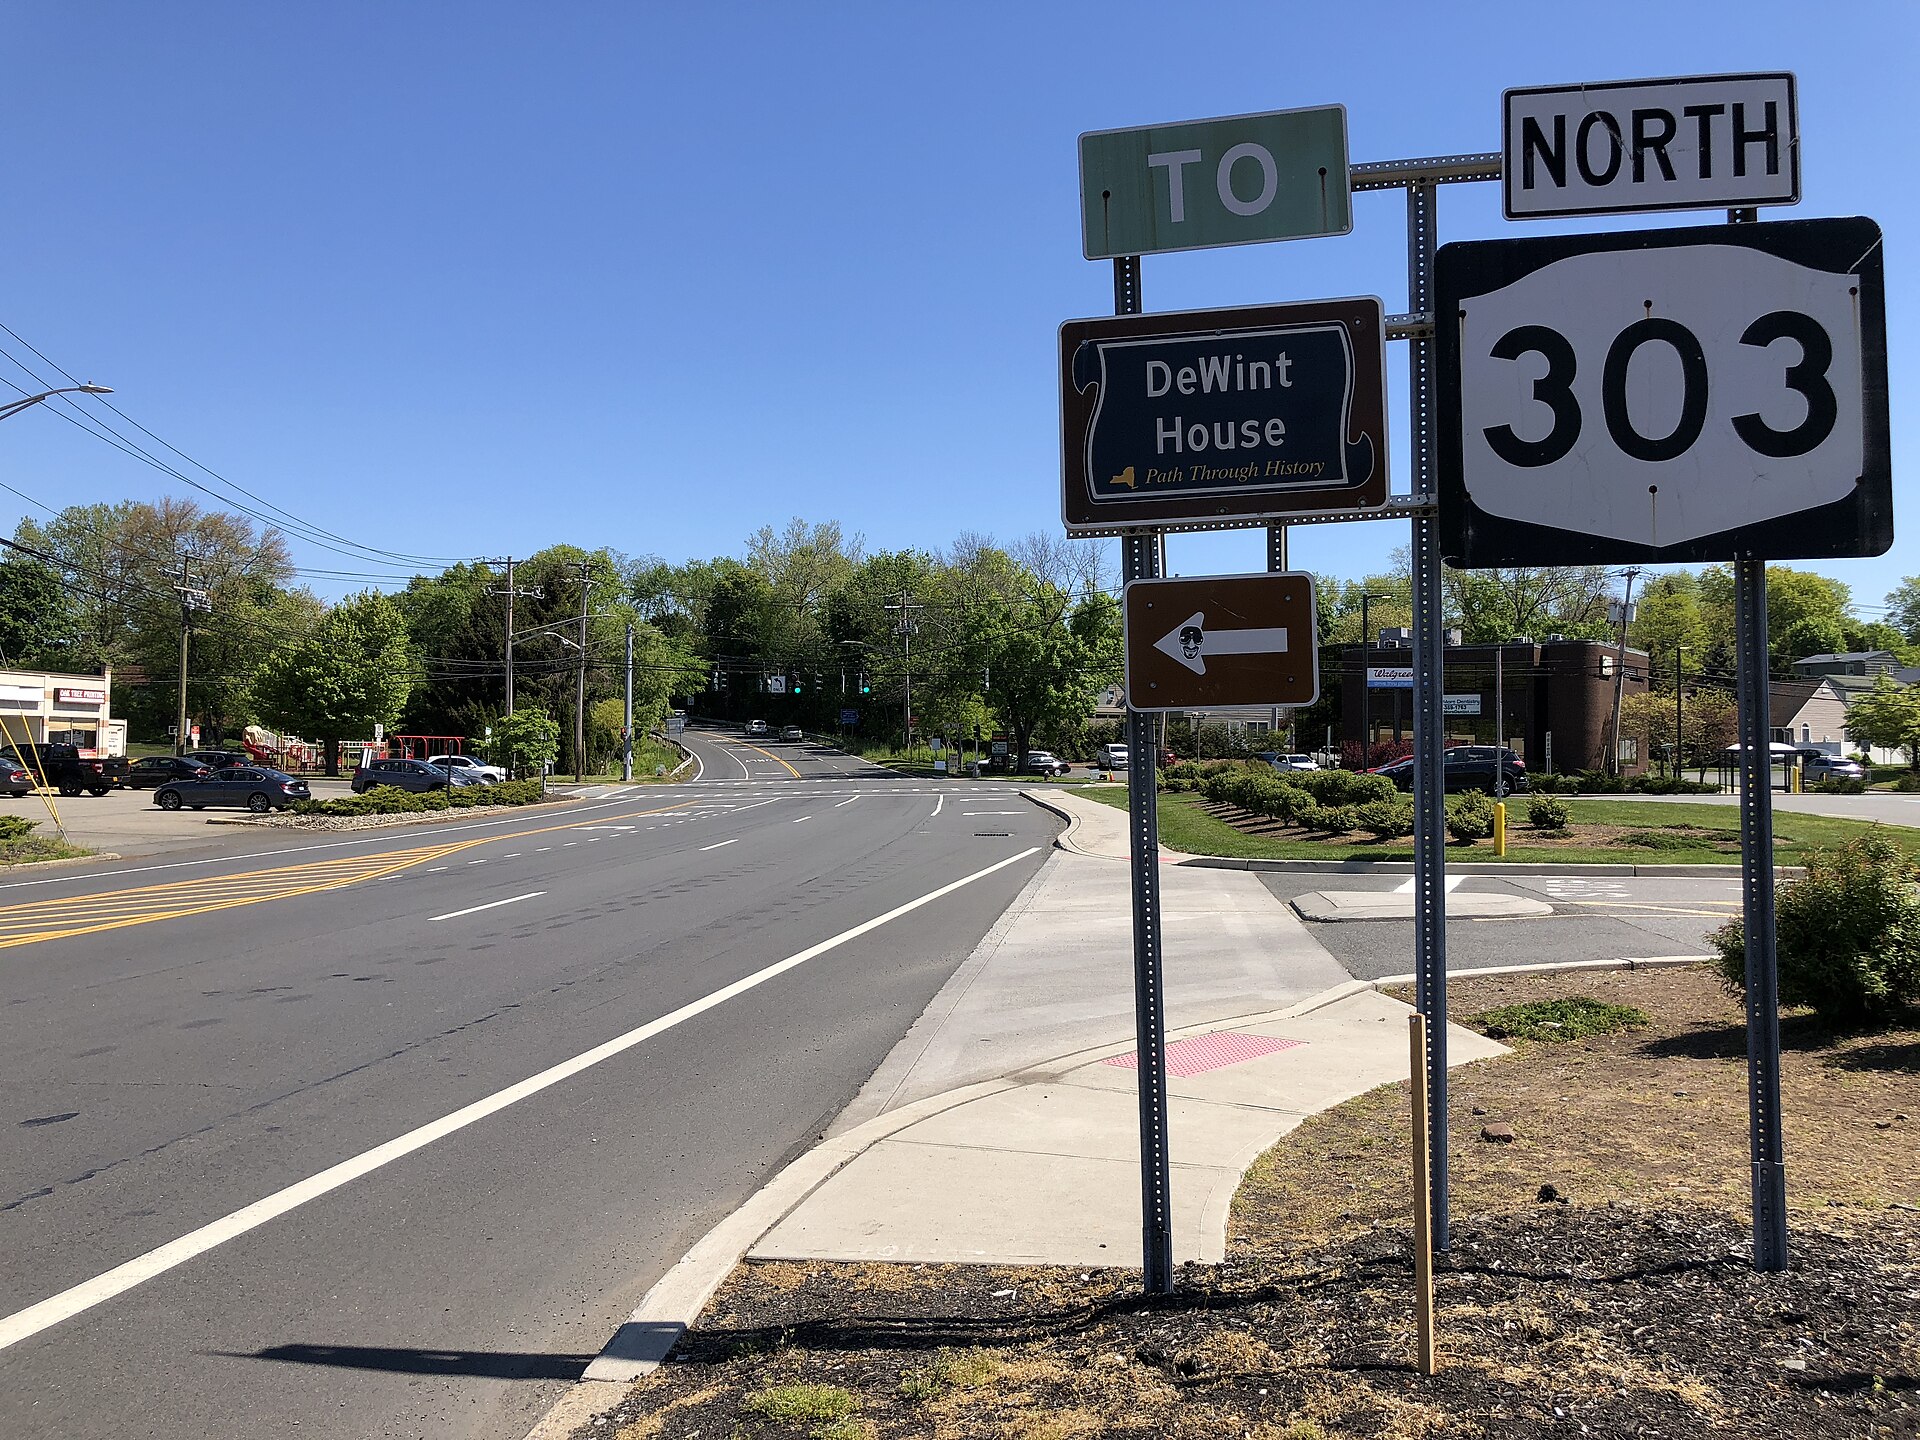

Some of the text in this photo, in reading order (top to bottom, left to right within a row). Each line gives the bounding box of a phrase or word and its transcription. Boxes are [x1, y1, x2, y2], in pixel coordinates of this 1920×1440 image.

[1522, 101, 1779, 190] NORTH
[1147, 142, 1278, 223] TO
[1146, 351, 1293, 397] DeWint
[1482, 310, 1838, 468] 303
[1156, 417, 1286, 454] House
[1145, 459, 1325, 488] Path Through History
[60, 689, 105, 699] OAK TREE PRINTING
[1374, 669, 1413, 680] Walgree
